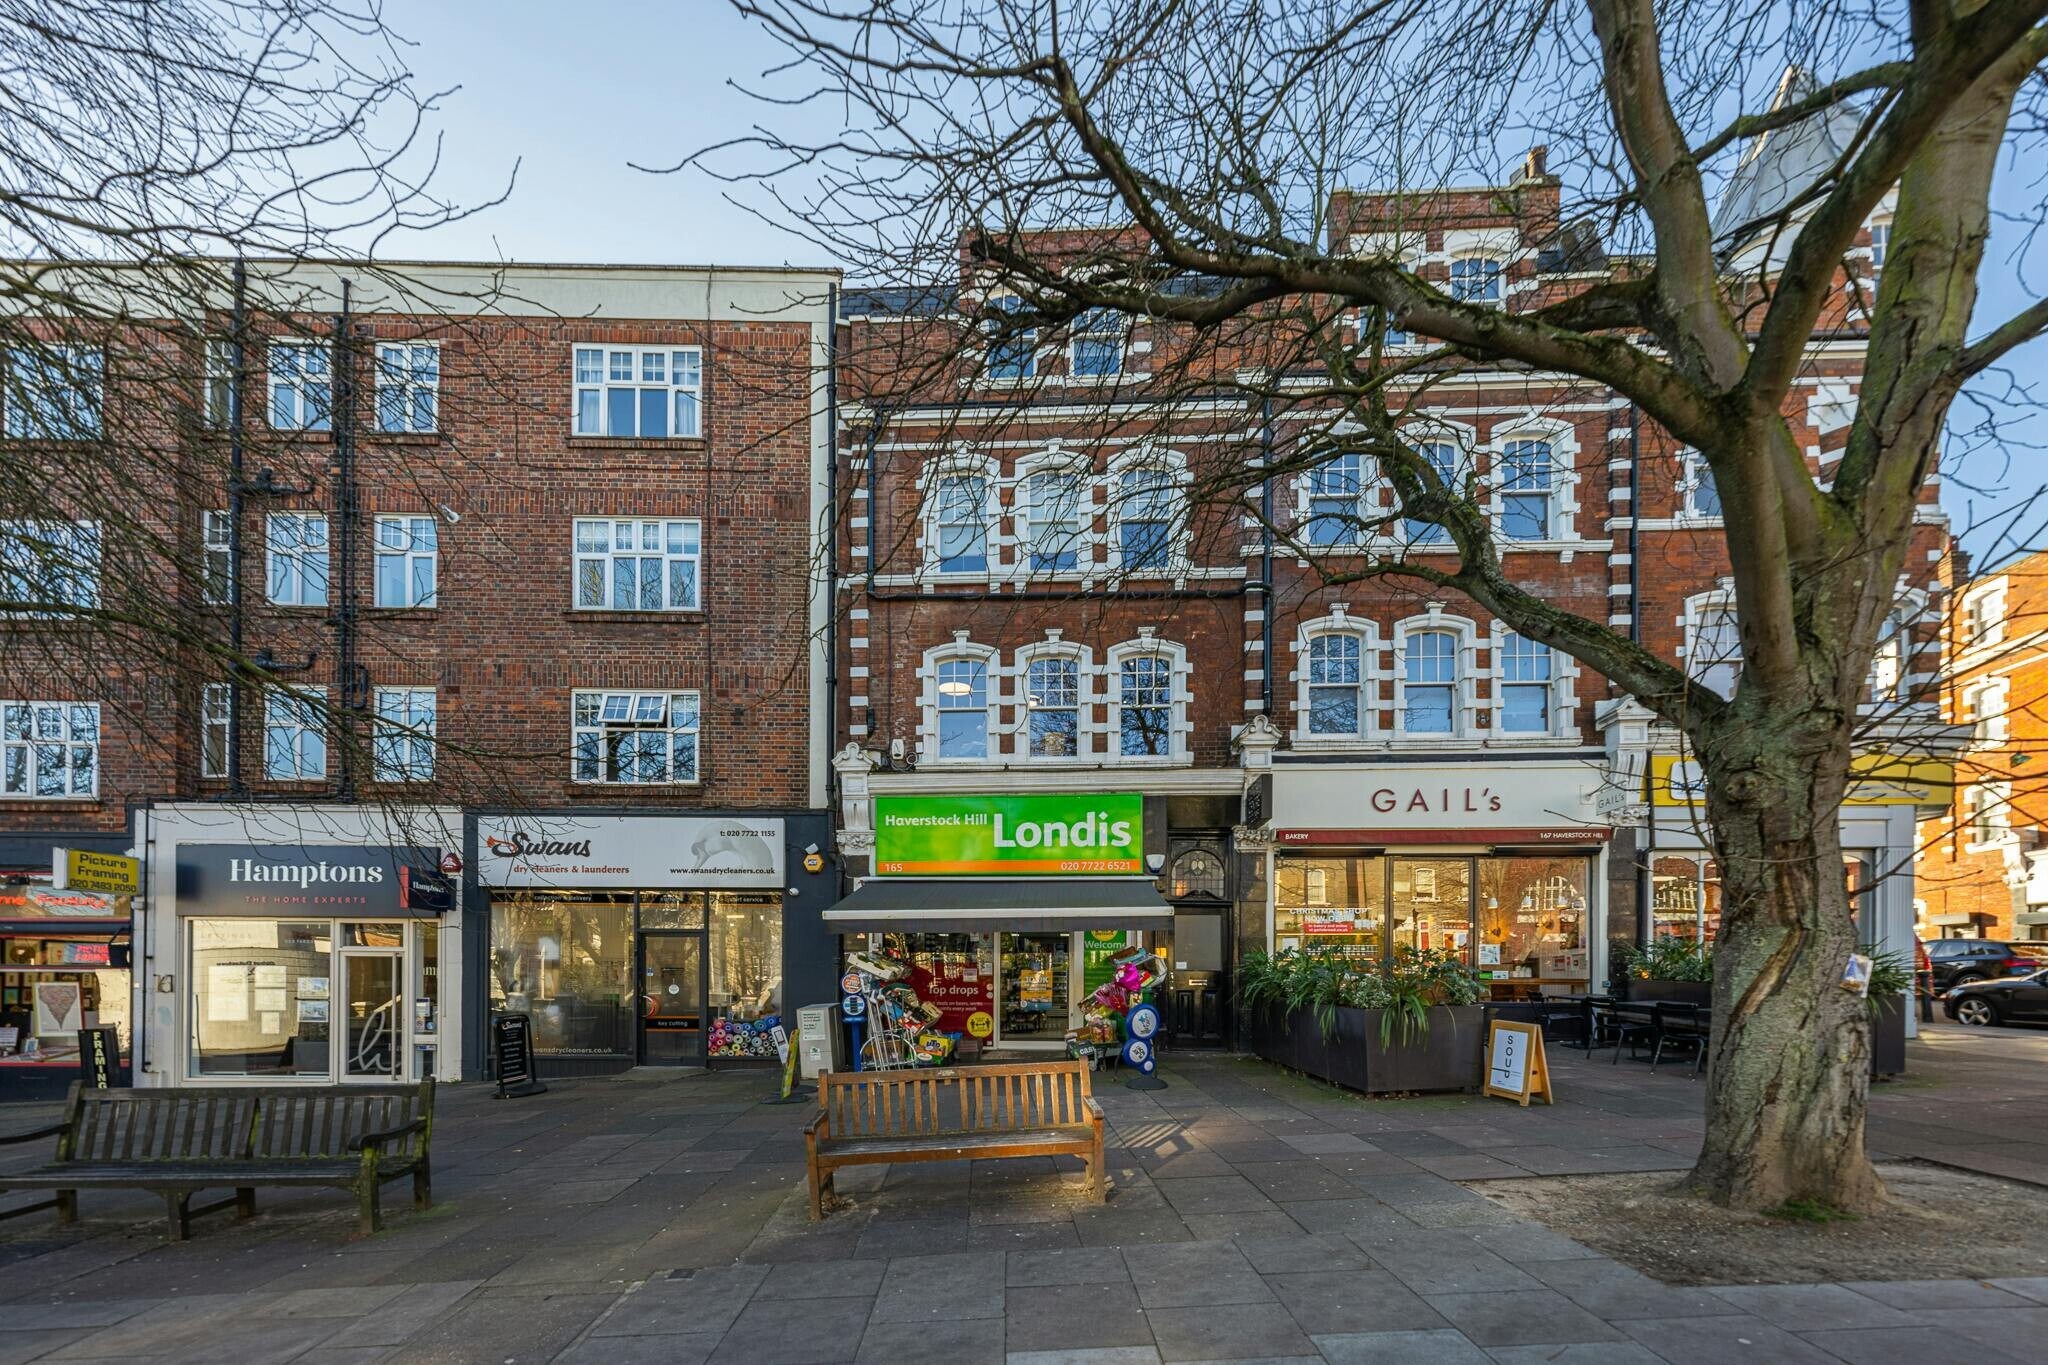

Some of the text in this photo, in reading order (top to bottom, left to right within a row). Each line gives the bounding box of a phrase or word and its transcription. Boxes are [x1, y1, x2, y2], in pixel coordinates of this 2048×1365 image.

[1371, 788, 1501, 812] GAIL's
[1598, 793, 1625, 808] GAIL's
[885, 813, 988, 826] Haverstock Hill
[993, 811, 1131, 847] Londis
[488, 832, 591, 857] Swans
[79, 853, 128, 868] Picture
[885, 862, 1131, 872] 165 020 7722 6521
[78, 866, 129, 882] Framing
[229, 859, 383, 888] Hamptons
[514, 865, 629, 875] dry cleaners & launderers
[670, 867, 775, 875] www.swansdrycleaners.co.uk
[69, 879, 137, 893] 020 7483 2050
[949, 985, 979, 997] drops
[93, 1031, 108, 1089] FRAMING
